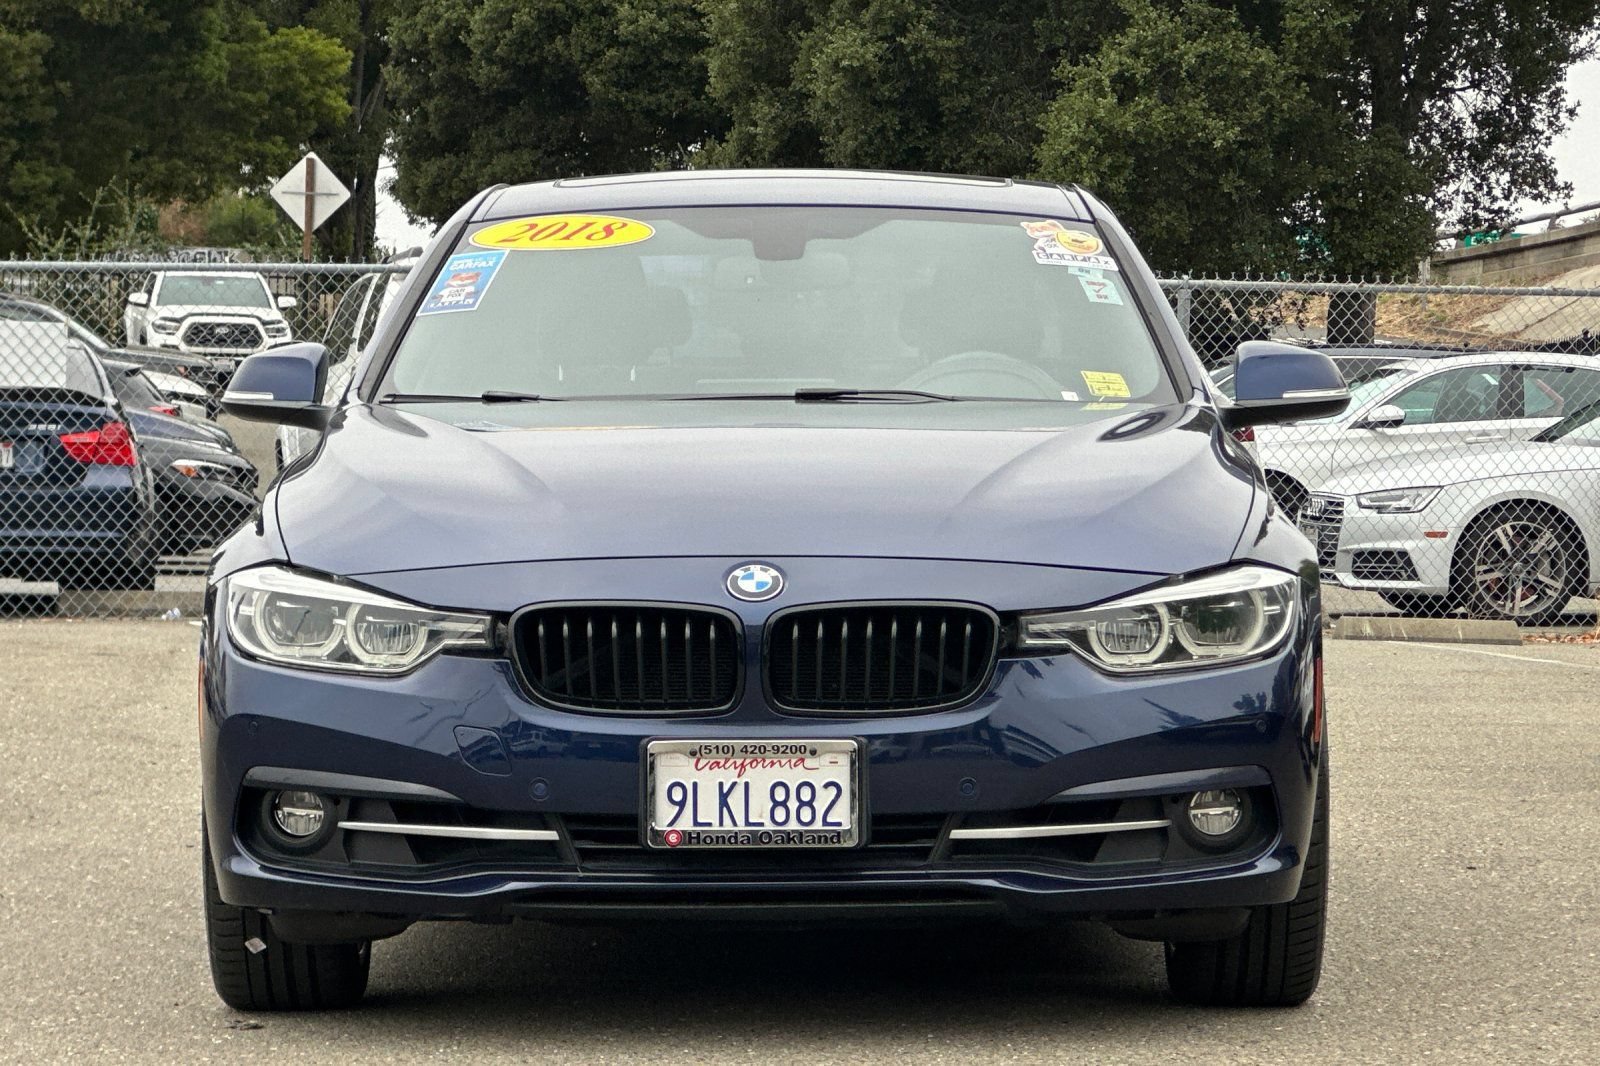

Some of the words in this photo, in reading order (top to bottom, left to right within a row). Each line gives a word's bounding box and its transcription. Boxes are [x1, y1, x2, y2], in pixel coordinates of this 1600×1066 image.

[496, 221, 628, 243] 2018
[449, 260, 495, 271] CARFAX
[699, 744, 736, 757] (510)
[740, 744, 807, 756] 420-9200
[694, 756, 820, 778] California
[666, 780, 843, 828] 9LKL882
[687, 831, 751, 845] Honda
[758, 831, 842, 845] Oakland
